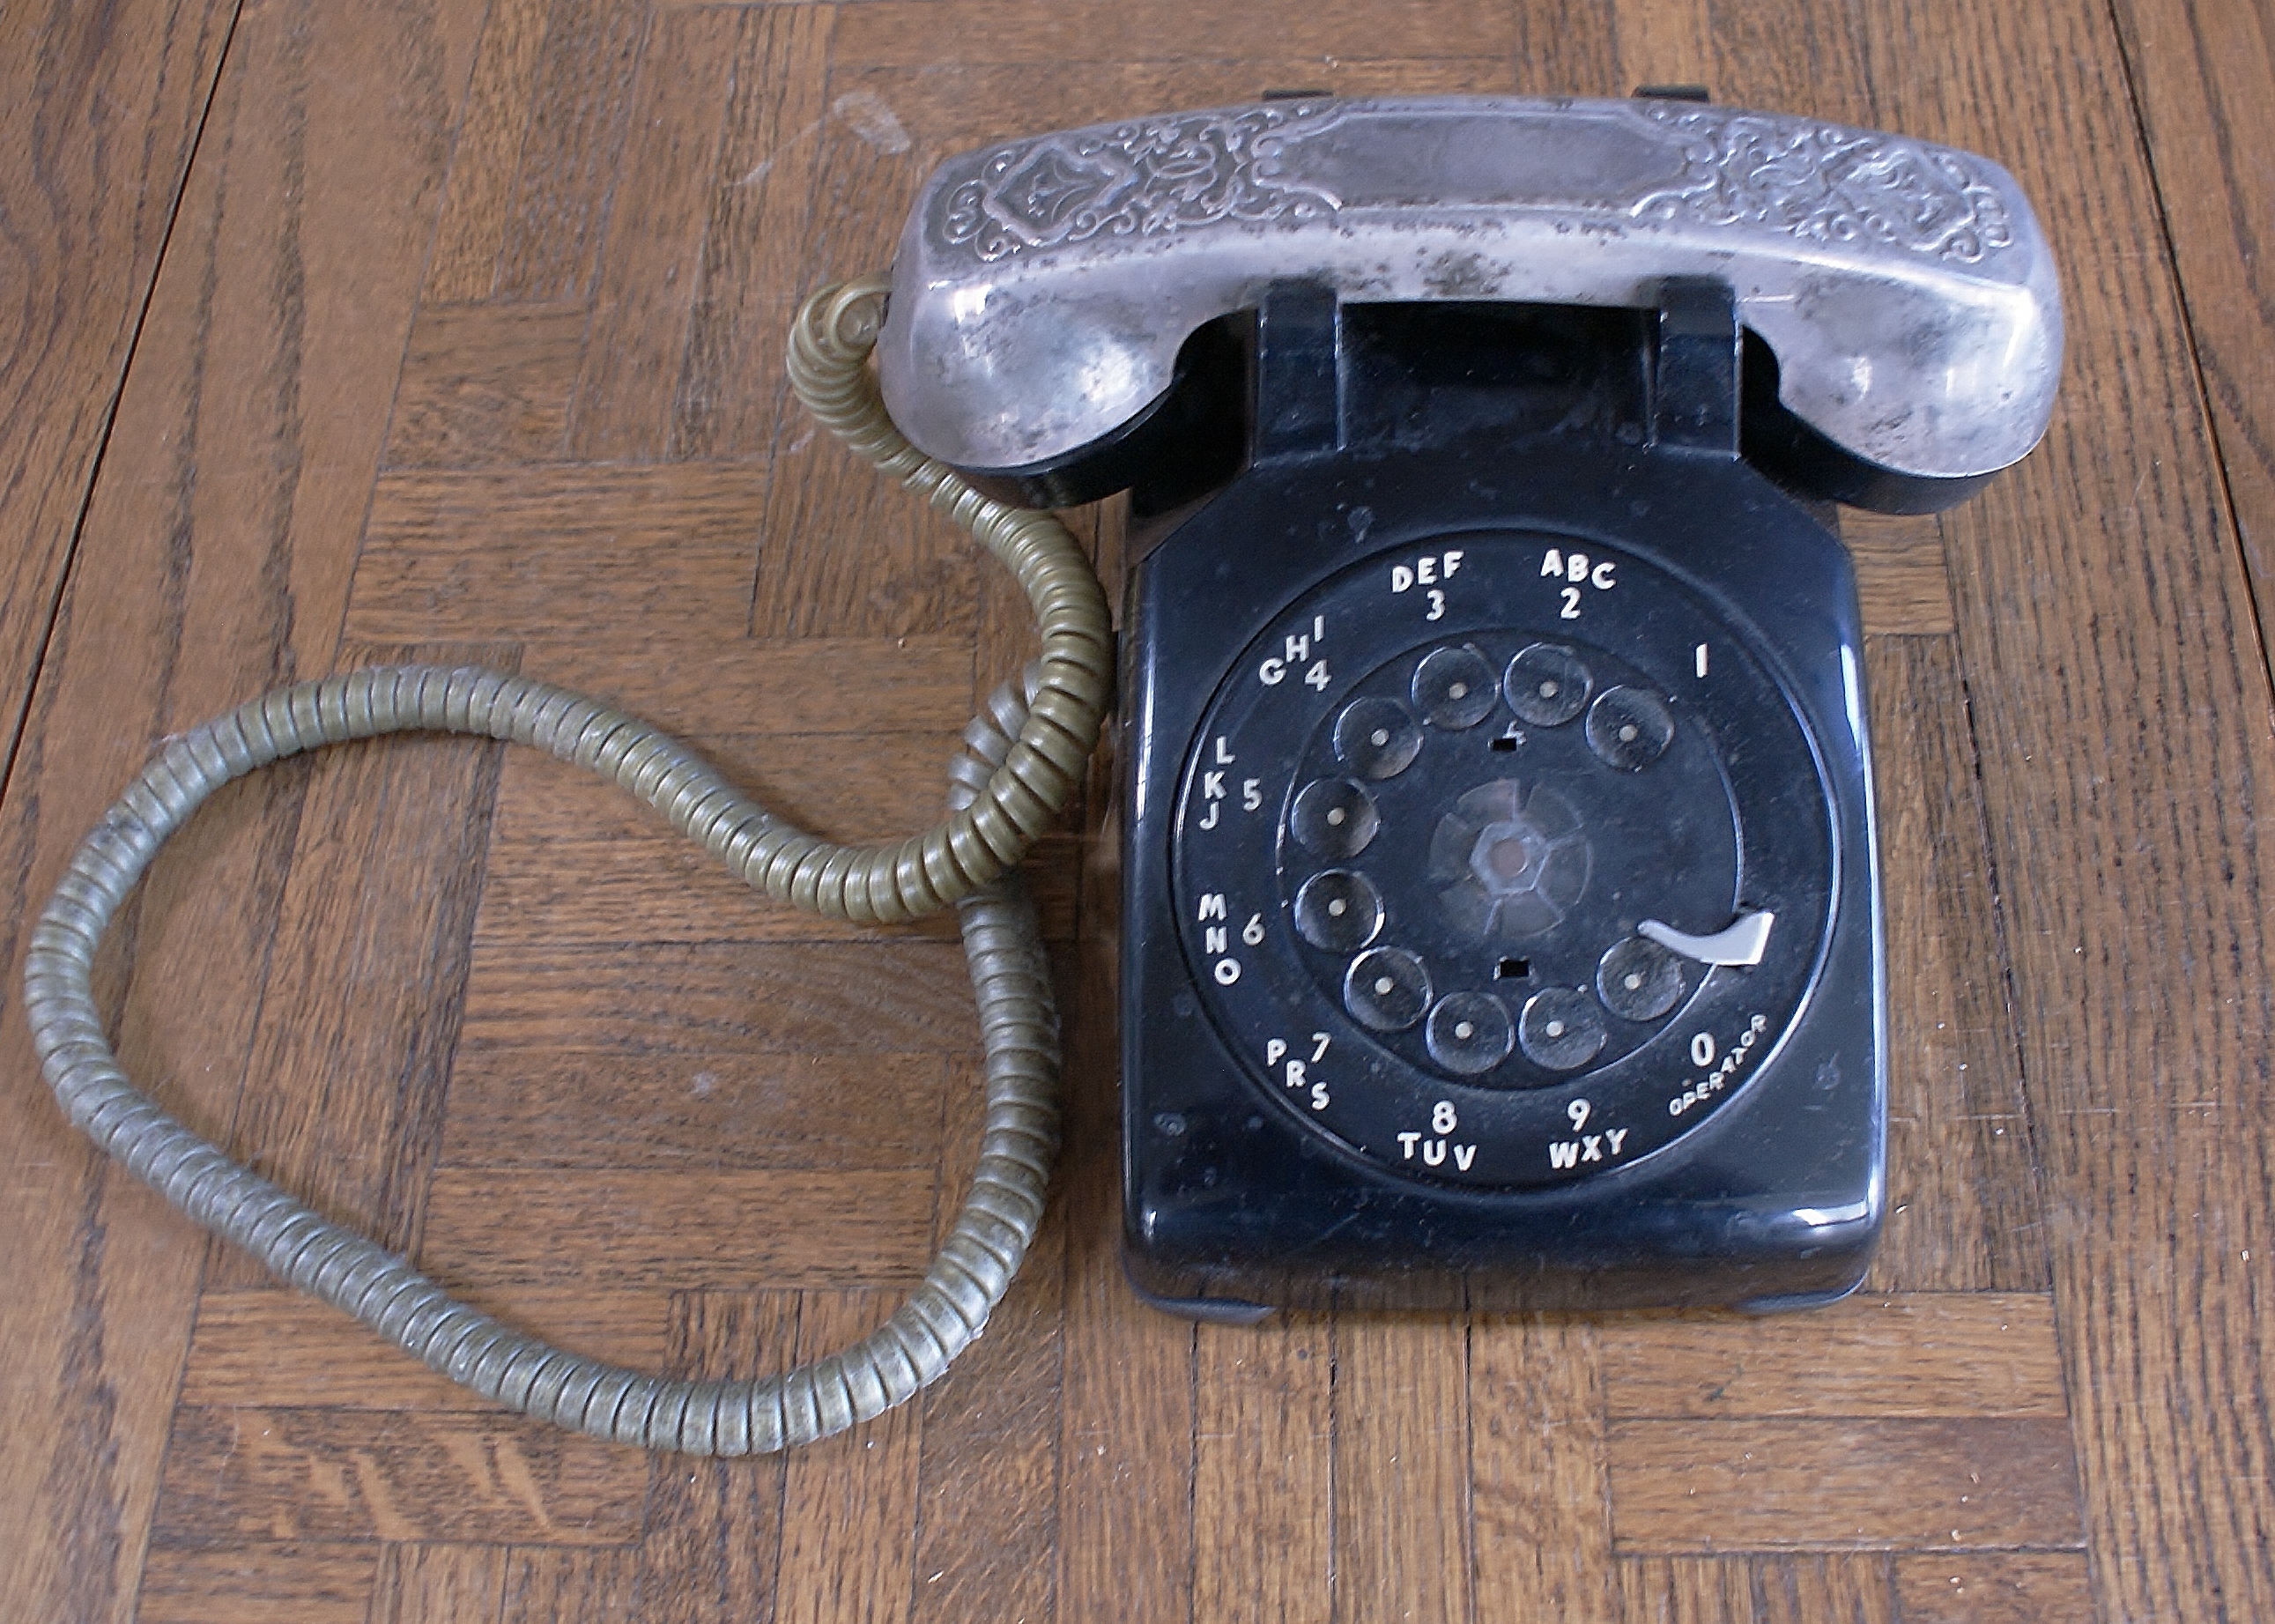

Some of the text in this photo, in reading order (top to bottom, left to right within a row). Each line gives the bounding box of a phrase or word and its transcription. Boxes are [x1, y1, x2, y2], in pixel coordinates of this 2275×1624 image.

[1391, 551, 1464, 593] DEF
[1540, 548, 1616, 590] ABC
[1426, 590, 1446, 621] 3
[1560, 587, 1582, 619] 2
[1258, 614, 1324, 686] GHI
[1304, 659, 1330, 692] 4
[1242, 779, 1262, 811] 5
[1242, 913, 1263, 945] 6
[1310, 1032, 1331, 1064] 7
[1668, 1014, 1767, 1116] OPERATOR
[1266, 1038, 1330, 1111] PRS
[1431, 1100, 1458, 1136] 8
[1567, 1098, 1591, 1133] 9
[1396, 1131, 1478, 1173] TUV
[1548, 1128, 1628, 1170] WXY
